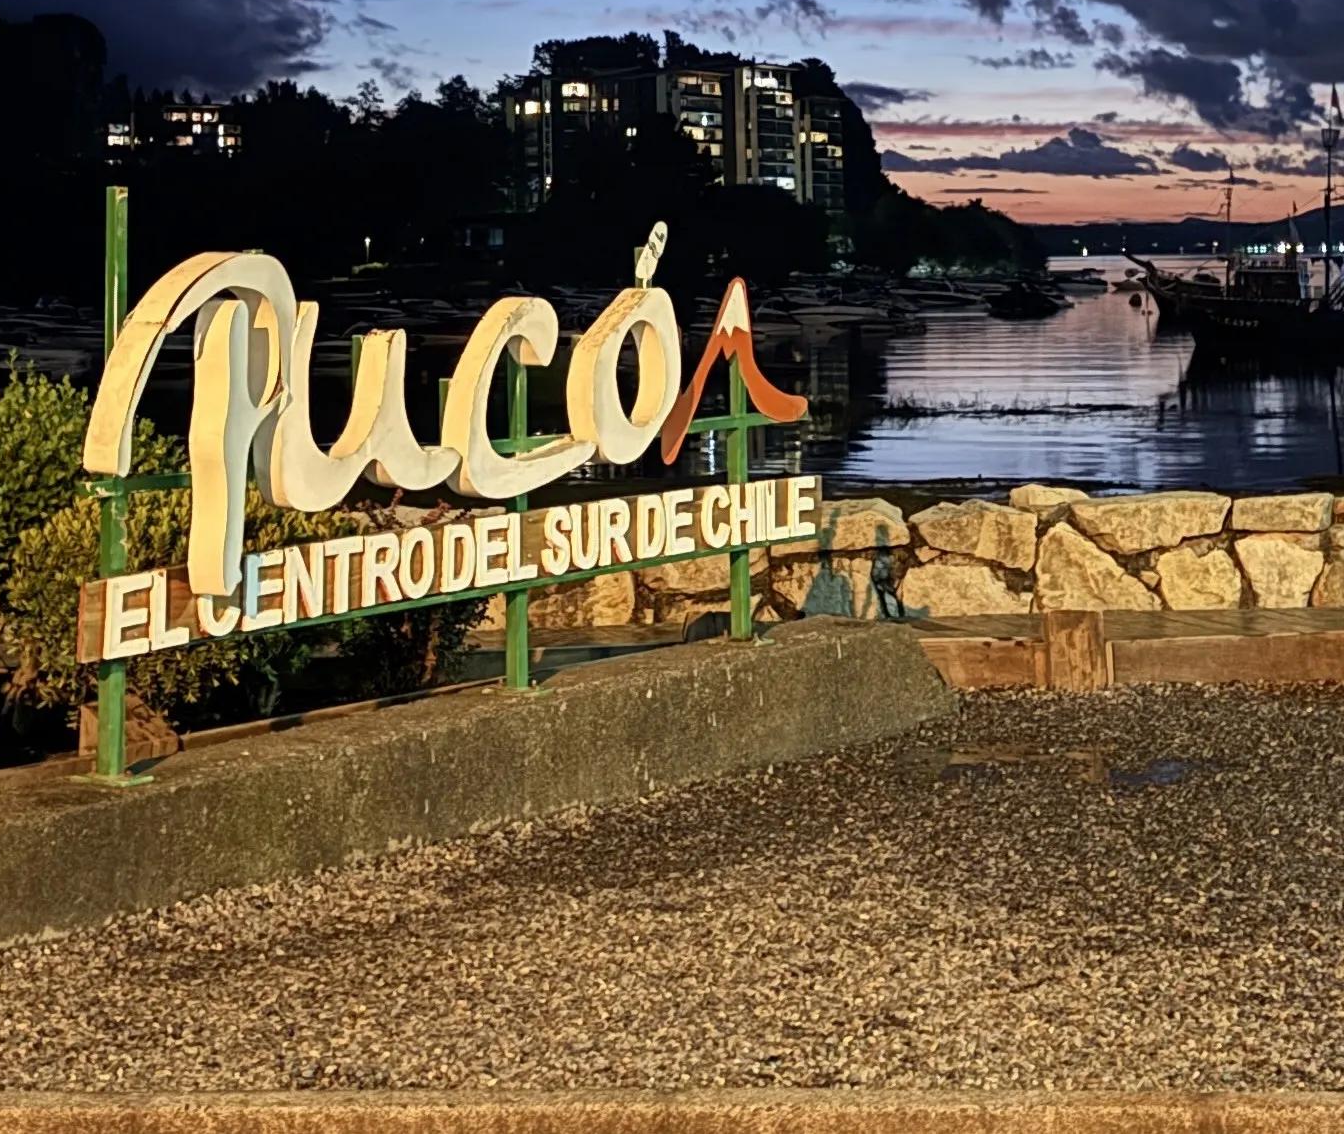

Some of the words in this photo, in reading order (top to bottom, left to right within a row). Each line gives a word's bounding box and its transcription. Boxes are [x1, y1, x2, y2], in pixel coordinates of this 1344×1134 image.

[103, 570, 189, 660] EL
[439, 513, 538, 593] DEL
[541, 499, 634, 575] SUR
[636, 488, 695, 559] DE
[701, 475, 816, 549] CHILE
